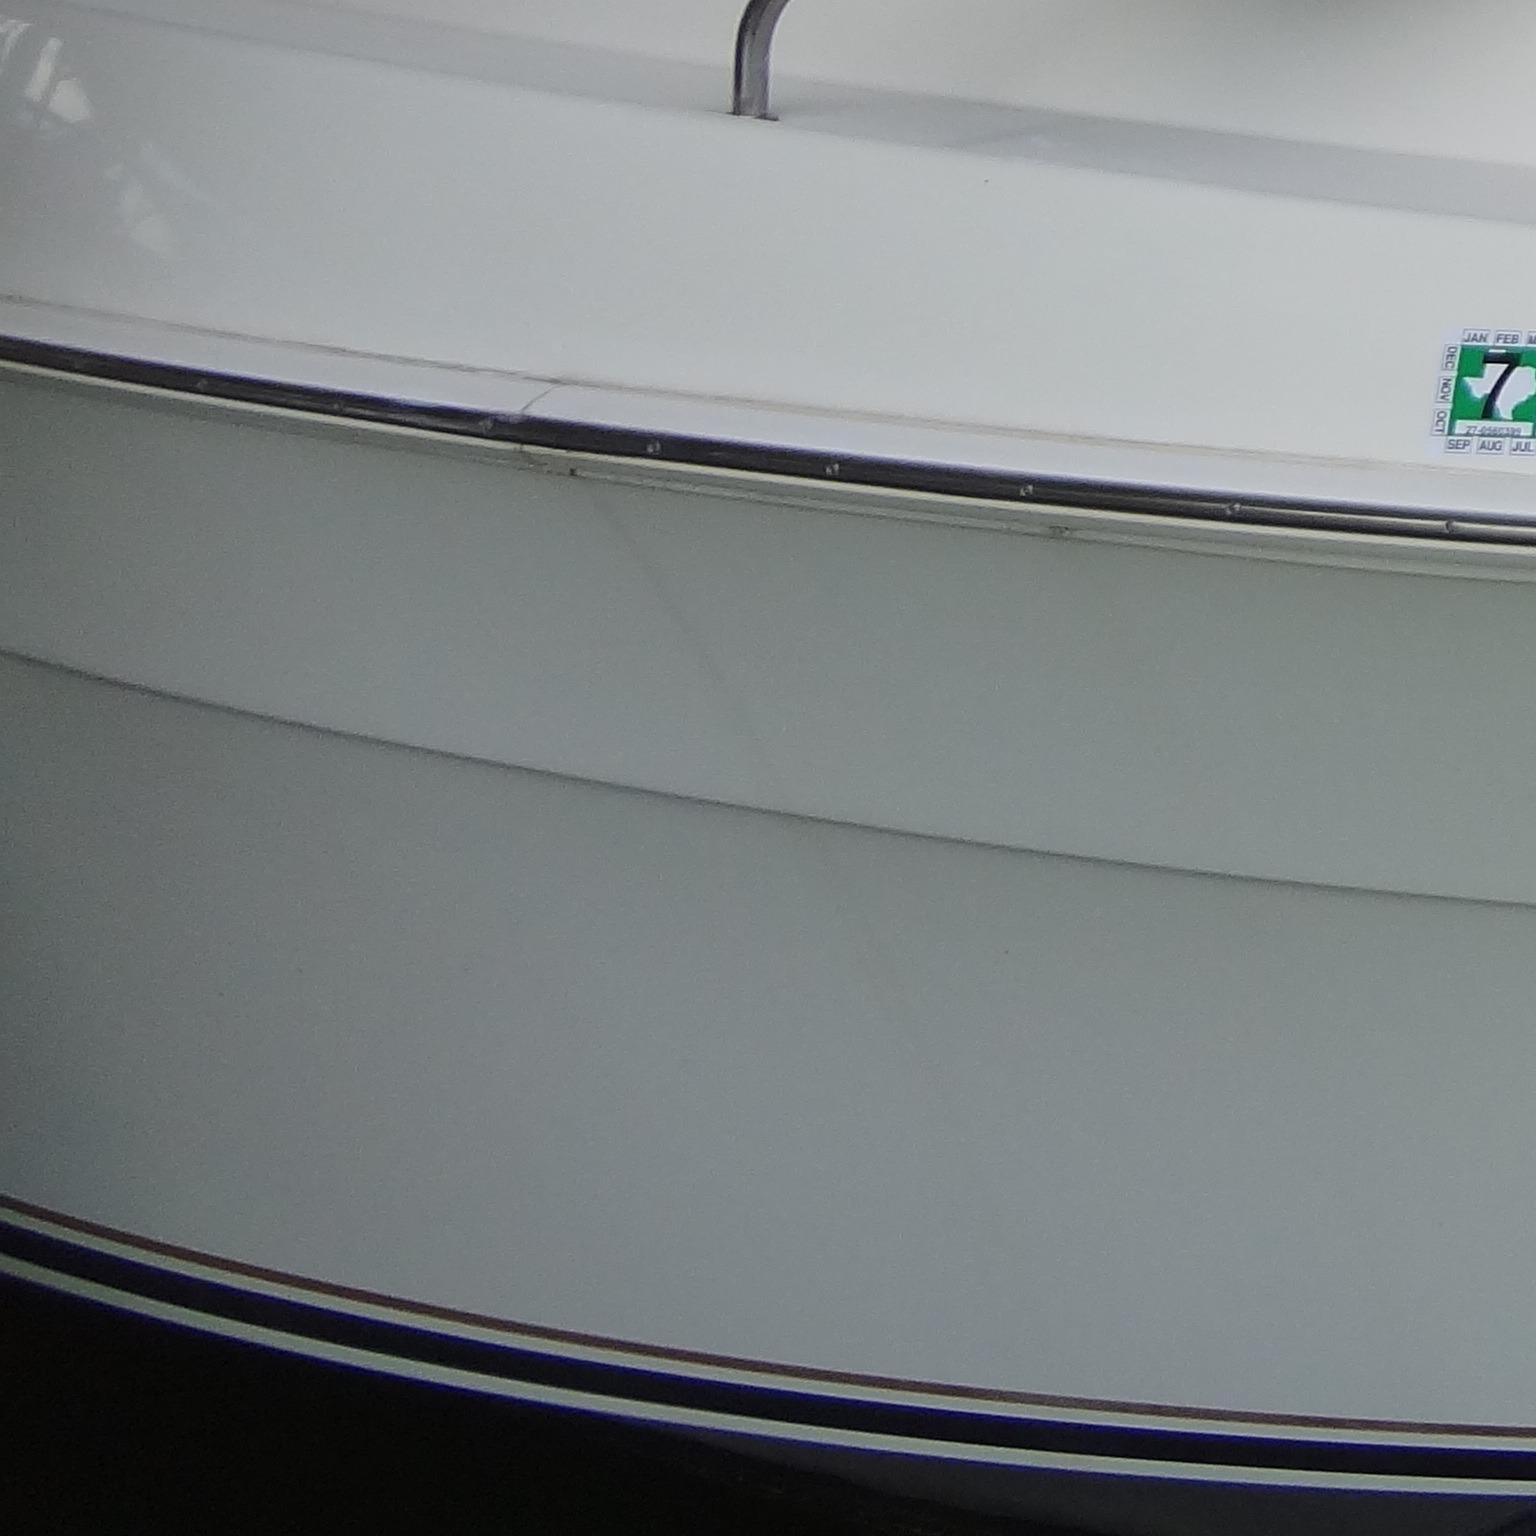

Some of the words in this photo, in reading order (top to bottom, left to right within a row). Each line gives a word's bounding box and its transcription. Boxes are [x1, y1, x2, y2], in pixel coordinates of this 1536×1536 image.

[1463, 332, 1488, 343] JAN
[1496, 333, 1520, 344] FEB
[1445, 346, 1457, 369] DEC
[1440, 378, 1452, 401] NOV
[1481, 352, 1522, 419] 7
[1434, 410, 1447, 433] OCT
[1448, 439, 1470, 450] SEP
[1480, 440, 1503, 451] AUG
[1512, 441, 1534, 452] JUL
